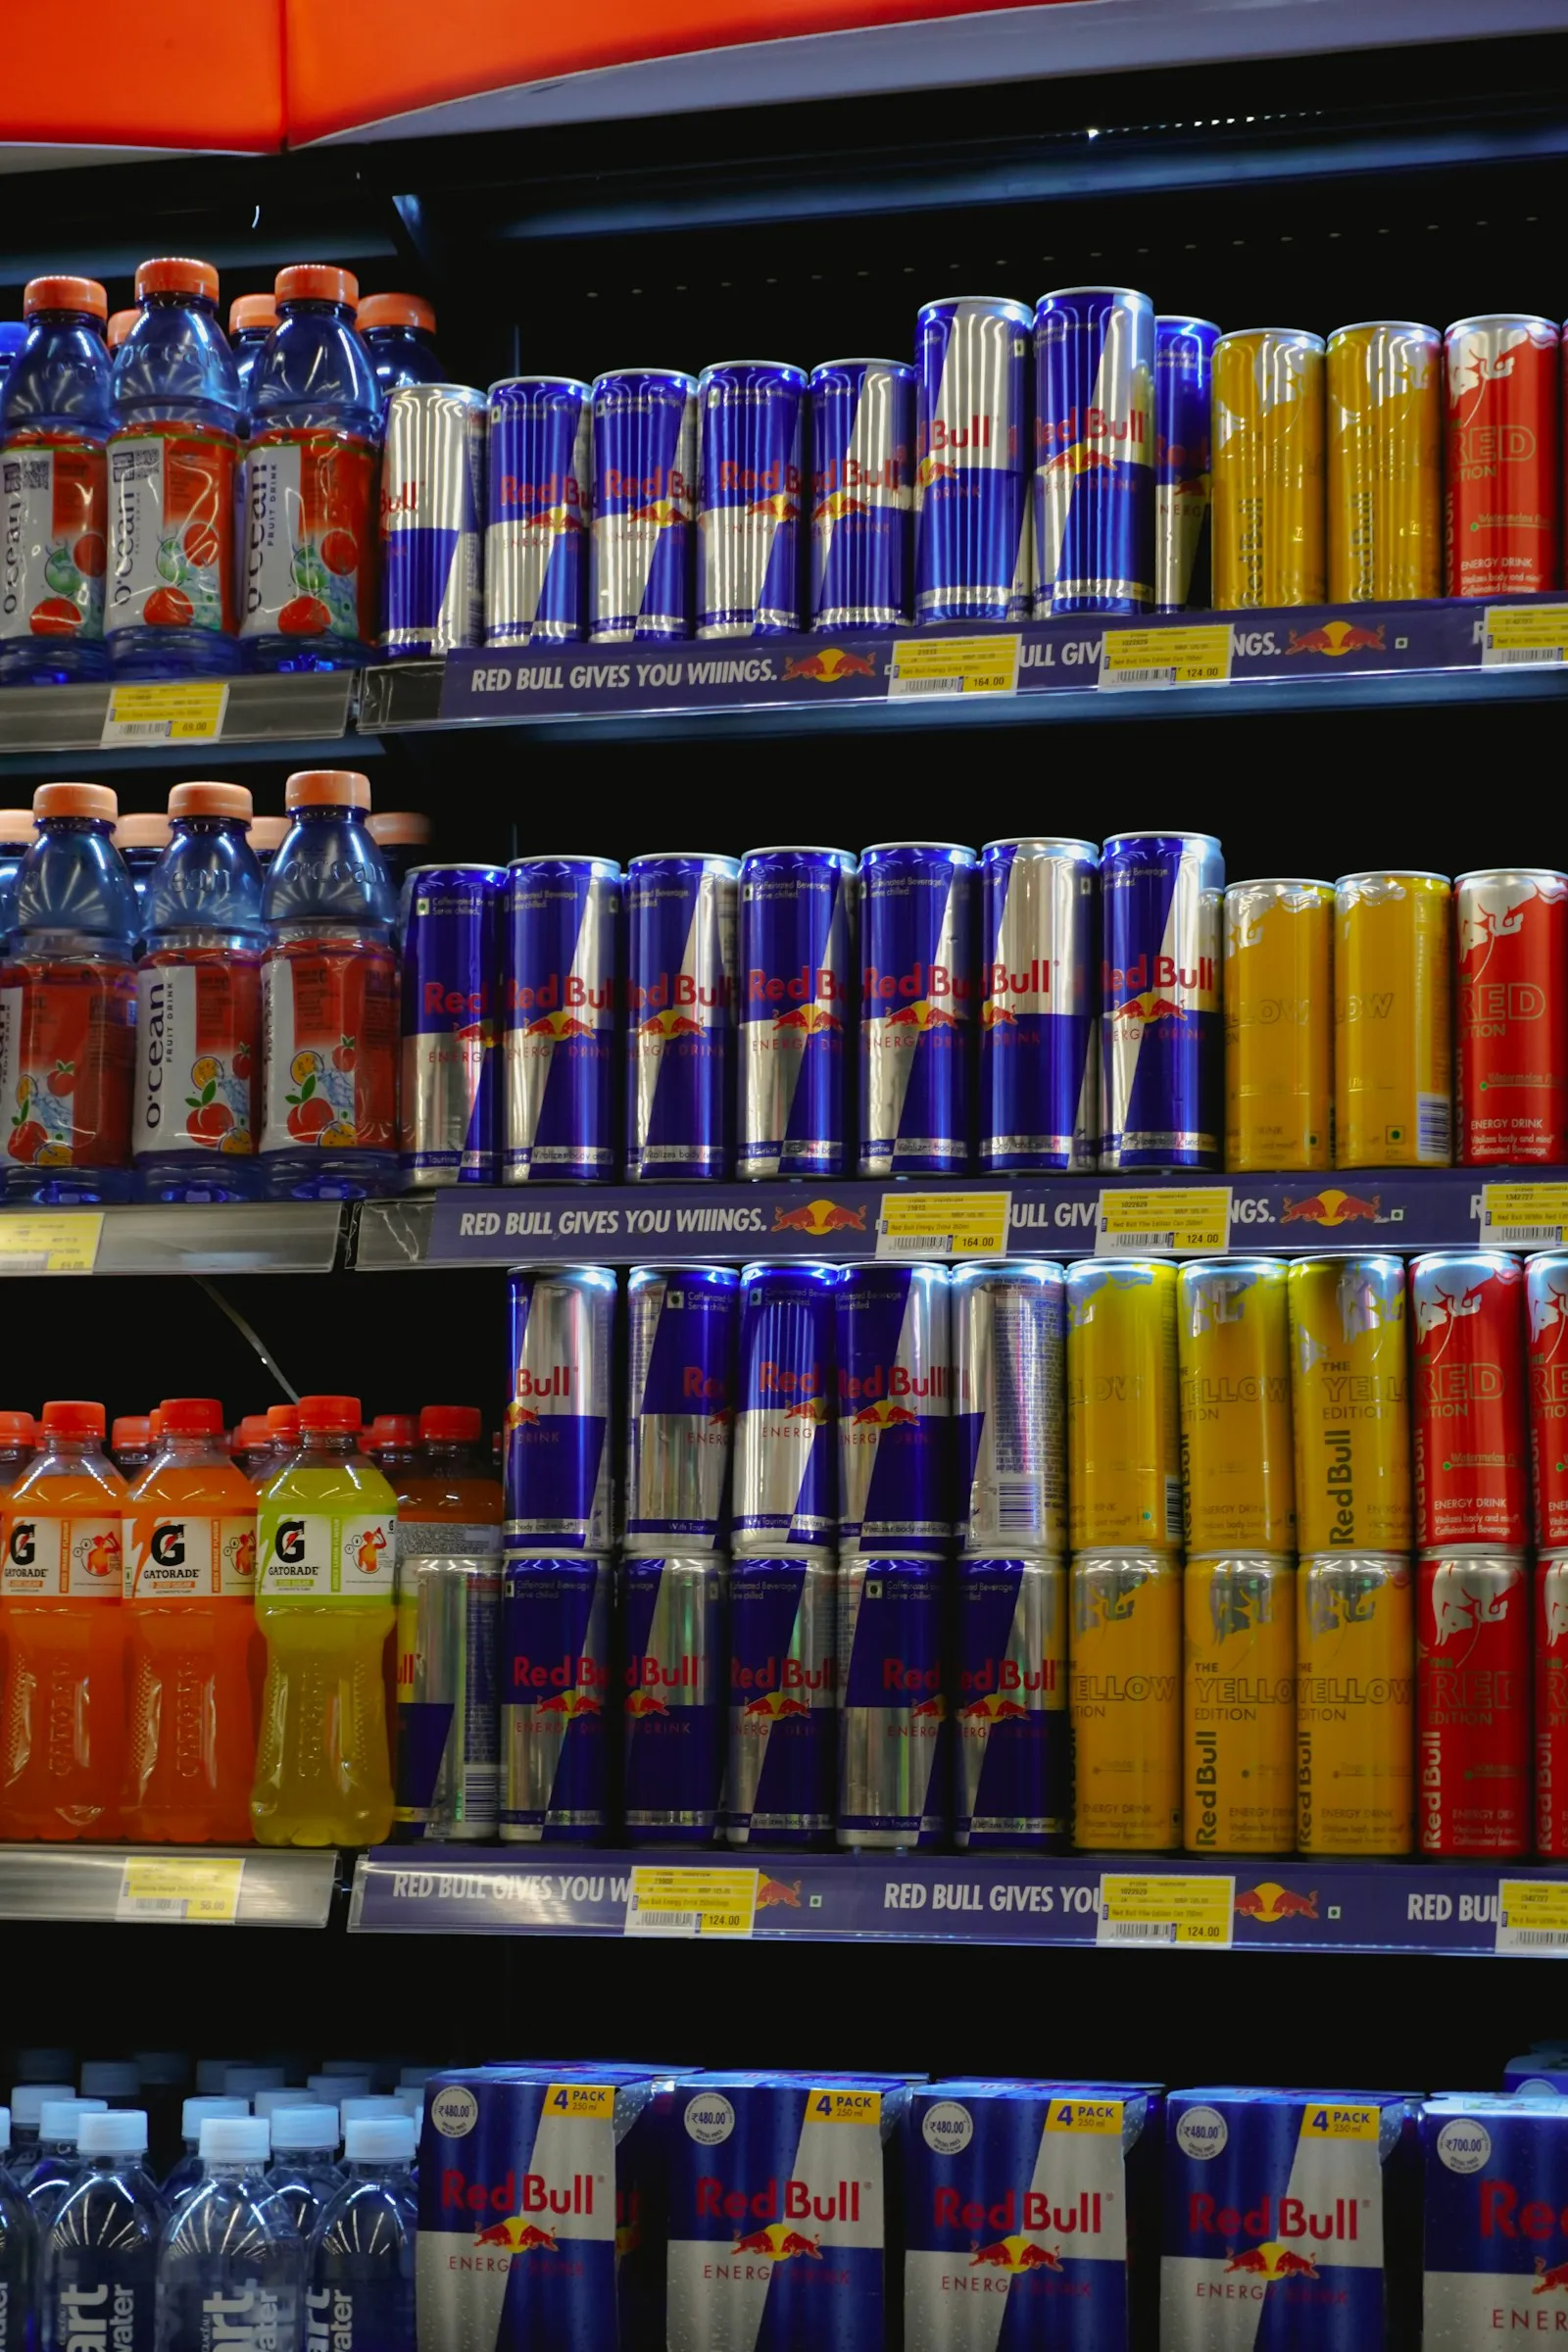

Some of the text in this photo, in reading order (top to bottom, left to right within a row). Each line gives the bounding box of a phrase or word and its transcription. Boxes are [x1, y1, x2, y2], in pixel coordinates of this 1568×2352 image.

[930, 415, 990, 451] Bull
[1085, 407, 1144, 444] Bull
[501, 473, 558, 507] Red
[605, 466, 662, 501] Red
[1060, 640, 1102, 666] GIV
[471, 658, 778, 693] RED BULL GIVES YOU WIIINGS.
[973, 676, 1005, 688] 164.00
[1187, 667, 1219, 678] 124.00
[749, 965, 810, 1003] Red
[864, 962, 923, 1001] Red
[992, 958, 1050, 996] Bull
[1153, 955, 1213, 992] Bull
[166, 982, 174, 1020] DRINK
[424, 981, 489, 1016] Red
[1471, 1118, 1544, 1130] ENERGY DRINK
[1497, 1133, 1535, 1145] body and
[461, 1206, 767, 1237] RED BULL GIVES YOU WIIINGS.
[961, 1237, 995, 1248] 164.00
[1187, 1233, 1220, 1245] 124.00
[516, 1365, 569, 1397] Bull
[760, 1361, 820, 1393] Red
[889, 1366, 944, 1397] Bull
[1322, 1361, 1350, 1372] THE
[1324, 1429, 1355, 1546] Red Bull
[1435, 1497, 1507, 1510] ENERGY DRINK
[144, 1569, 200, 1579] GATORADE
[269, 1566, 318, 1576] GATORADE
[514, 1655, 571, 1688] Red
[641, 1655, 698, 1688] Bull
[883, 1658, 940, 1691] Red
[1000, 1659, 1056, 1691] Bull
[1194, 1662, 1219, 1673] THE
[1071, 1675, 1176, 1702] ELLOW
[1195, 1707, 1257, 1722] EDITION
[1196, 1731, 1218, 1846] Red Bull
[1422, 1731, 1443, 1849] Red Bull
[394, 1873, 606, 1902] RED BULL GIVES YOU
[884, 1883, 1054, 1913] RED BULL GIVES
[709, 1915, 740, 1926] 124.00
[1407, 1893, 1453, 1921] RED
[1187, 1926, 1220, 1937] 124.00
[553, 2089, 606, 2110] 4 PACK
[815, 2095, 871, 2117] 4 PACK
[836, 2108, 863, 2117] 250 ml
[1056, 2105, 1114, 2127] 4 PACK
[1078, 2118, 1095, 2128] 250
[1312, 2110, 1370, 2132] 4 PACK
[1333, 2124, 1351, 2133] 250
[443, 2169, 594, 2215] Red Bull
[695, 2177, 859, 2223] Red Bull
[934, 2186, 1102, 2234] Red Bull
[1189, 2192, 1358, 2241] Red Bull
